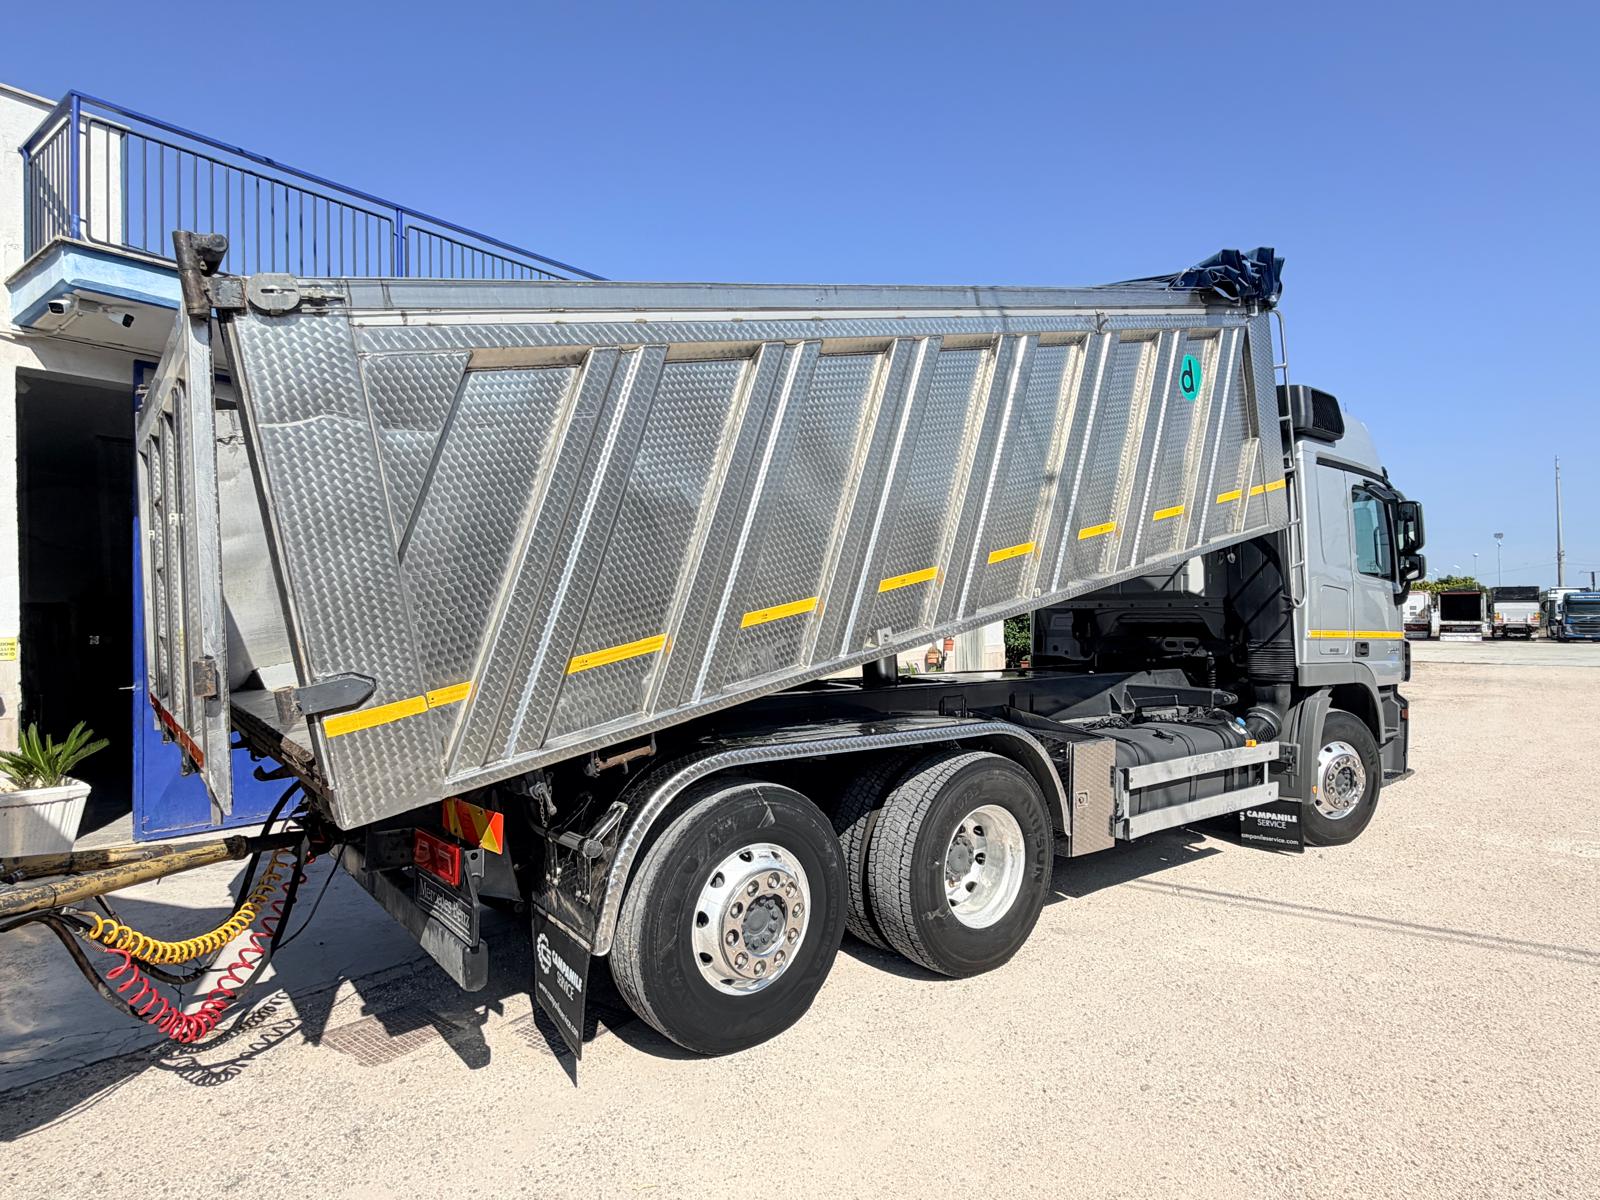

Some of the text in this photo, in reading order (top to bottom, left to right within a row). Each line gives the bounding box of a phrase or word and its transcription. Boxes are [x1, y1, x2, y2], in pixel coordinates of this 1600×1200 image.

[1181, 359, 1195, 393] d
[1246, 810, 1298, 823] CAMPANILE
[1257, 819, 1287, 829] SERVICE
[551, 949, 583, 993] CAMPANILE
[556, 970, 575, 1001] SERVICE
